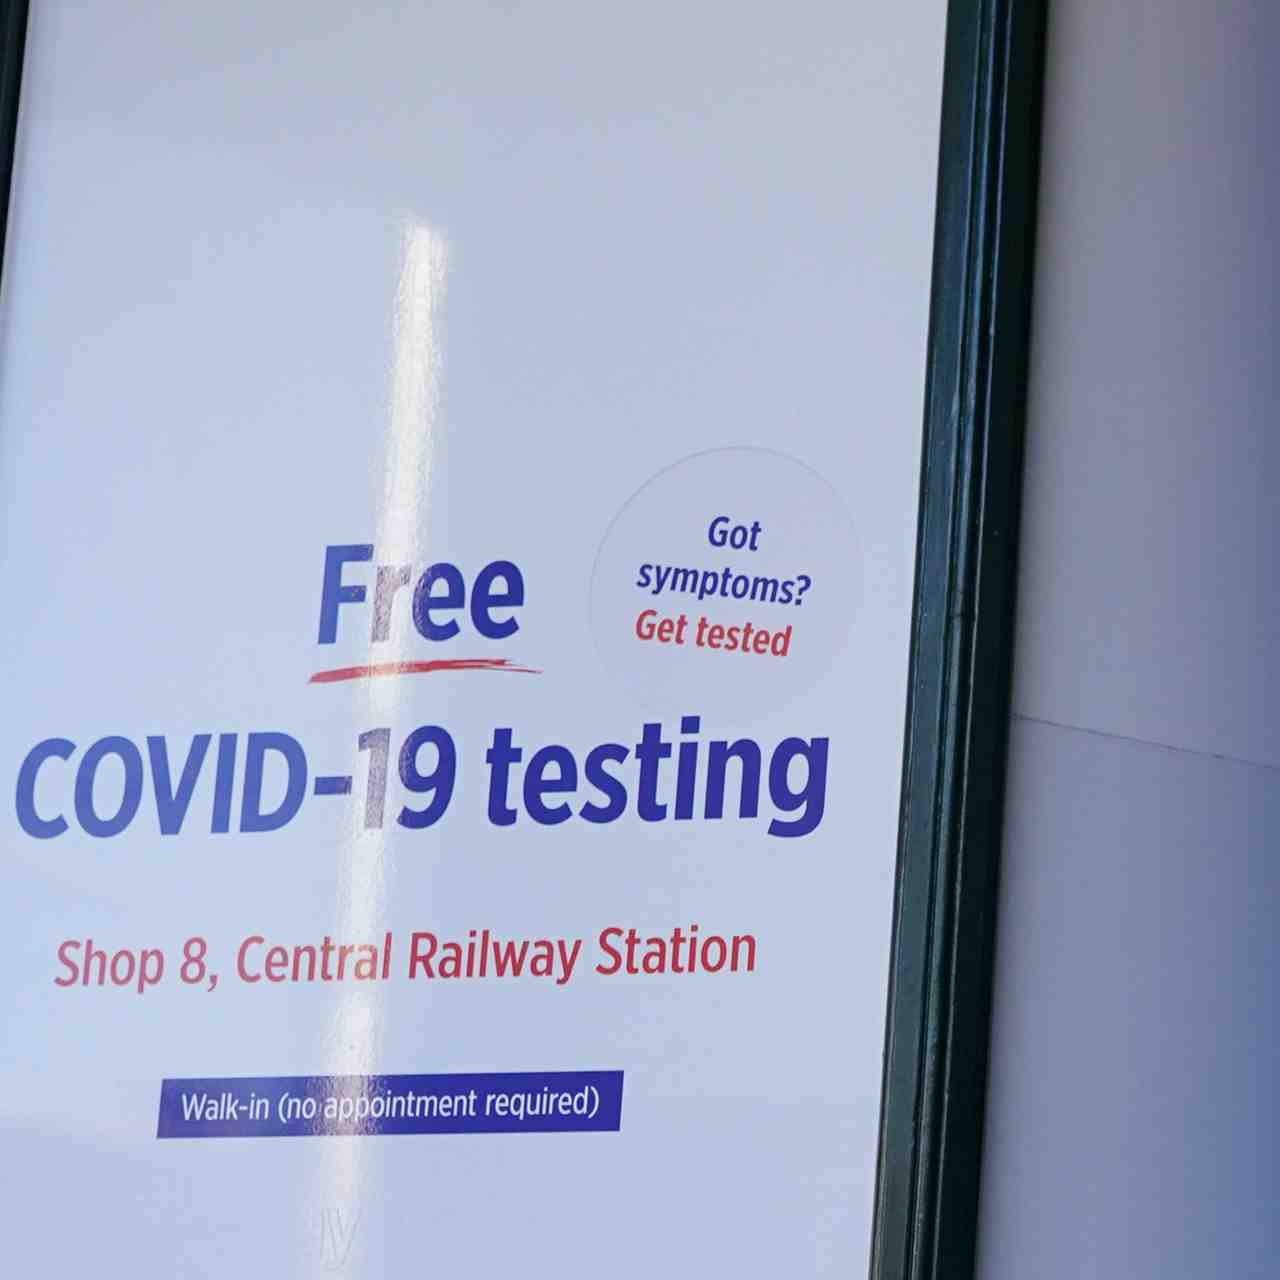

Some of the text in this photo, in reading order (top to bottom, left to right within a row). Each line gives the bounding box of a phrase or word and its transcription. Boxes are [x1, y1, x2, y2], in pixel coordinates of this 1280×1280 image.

[708, 516, 762, 551] Got
[318, 543, 525, 645] Free
[636, 562, 812, 606] symptoms?
[635, 609, 793, 657] Get tested
[14, 716, 830, 840] COVID-19 testing
[55, 924, 757, 994] Shop 8, Central Railway Station
[181, 1086, 600, 1126] Walk-in (no appointment required)
